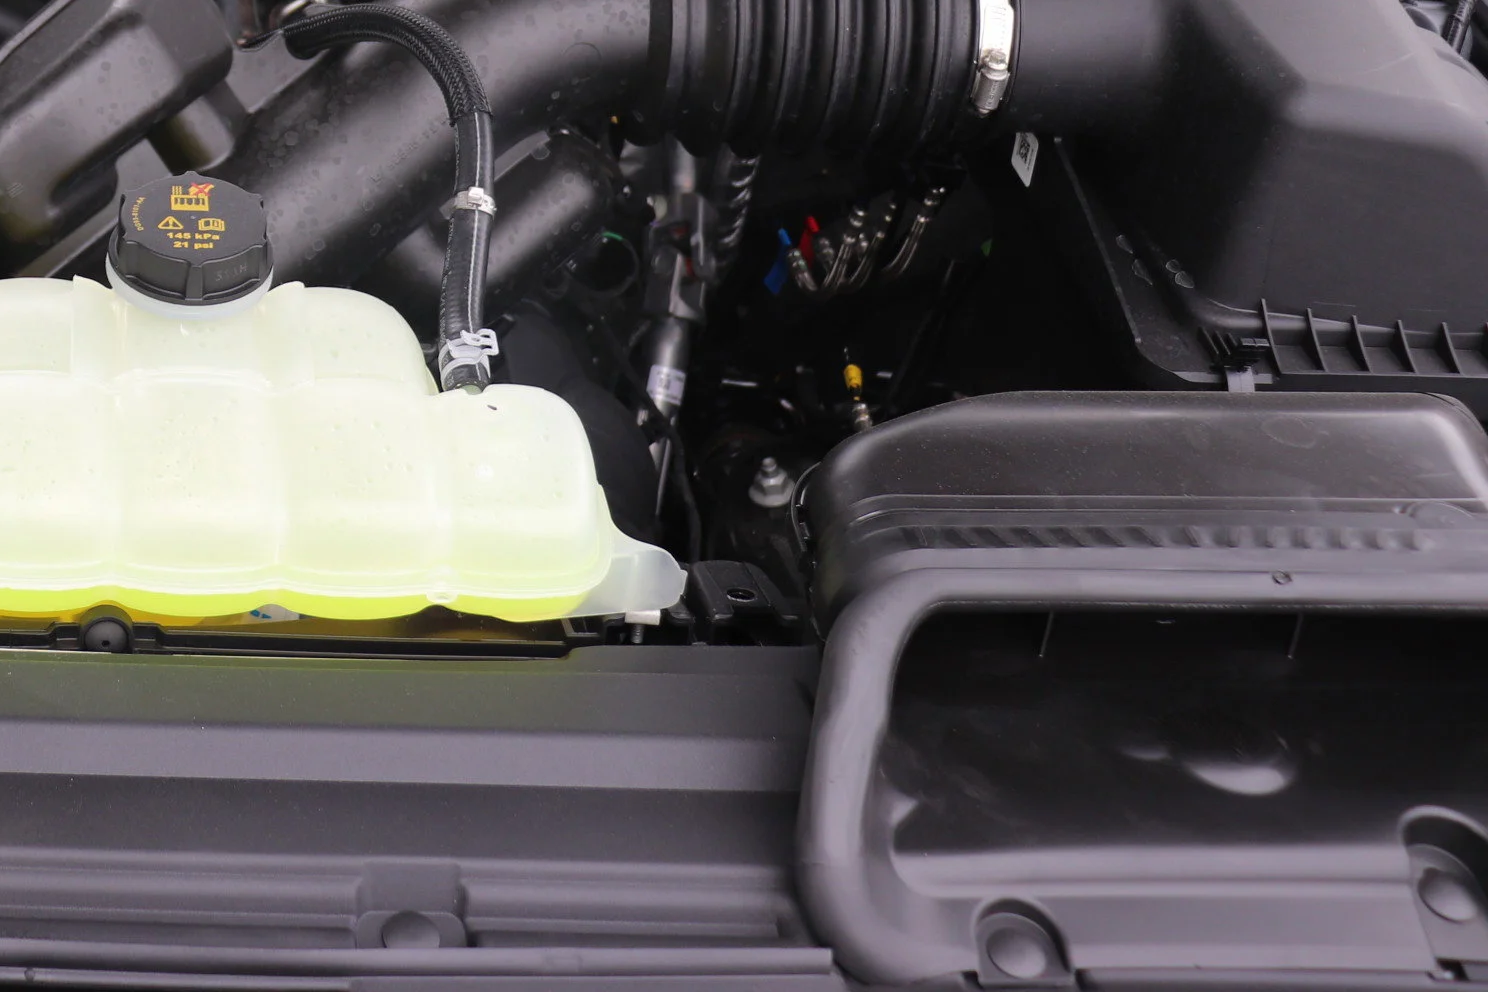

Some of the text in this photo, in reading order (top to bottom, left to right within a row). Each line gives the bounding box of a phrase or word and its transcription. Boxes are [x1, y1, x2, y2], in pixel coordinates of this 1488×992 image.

[166, 232, 221, 240] 145 kPa
[173, 241, 214, 250] 21 psi
